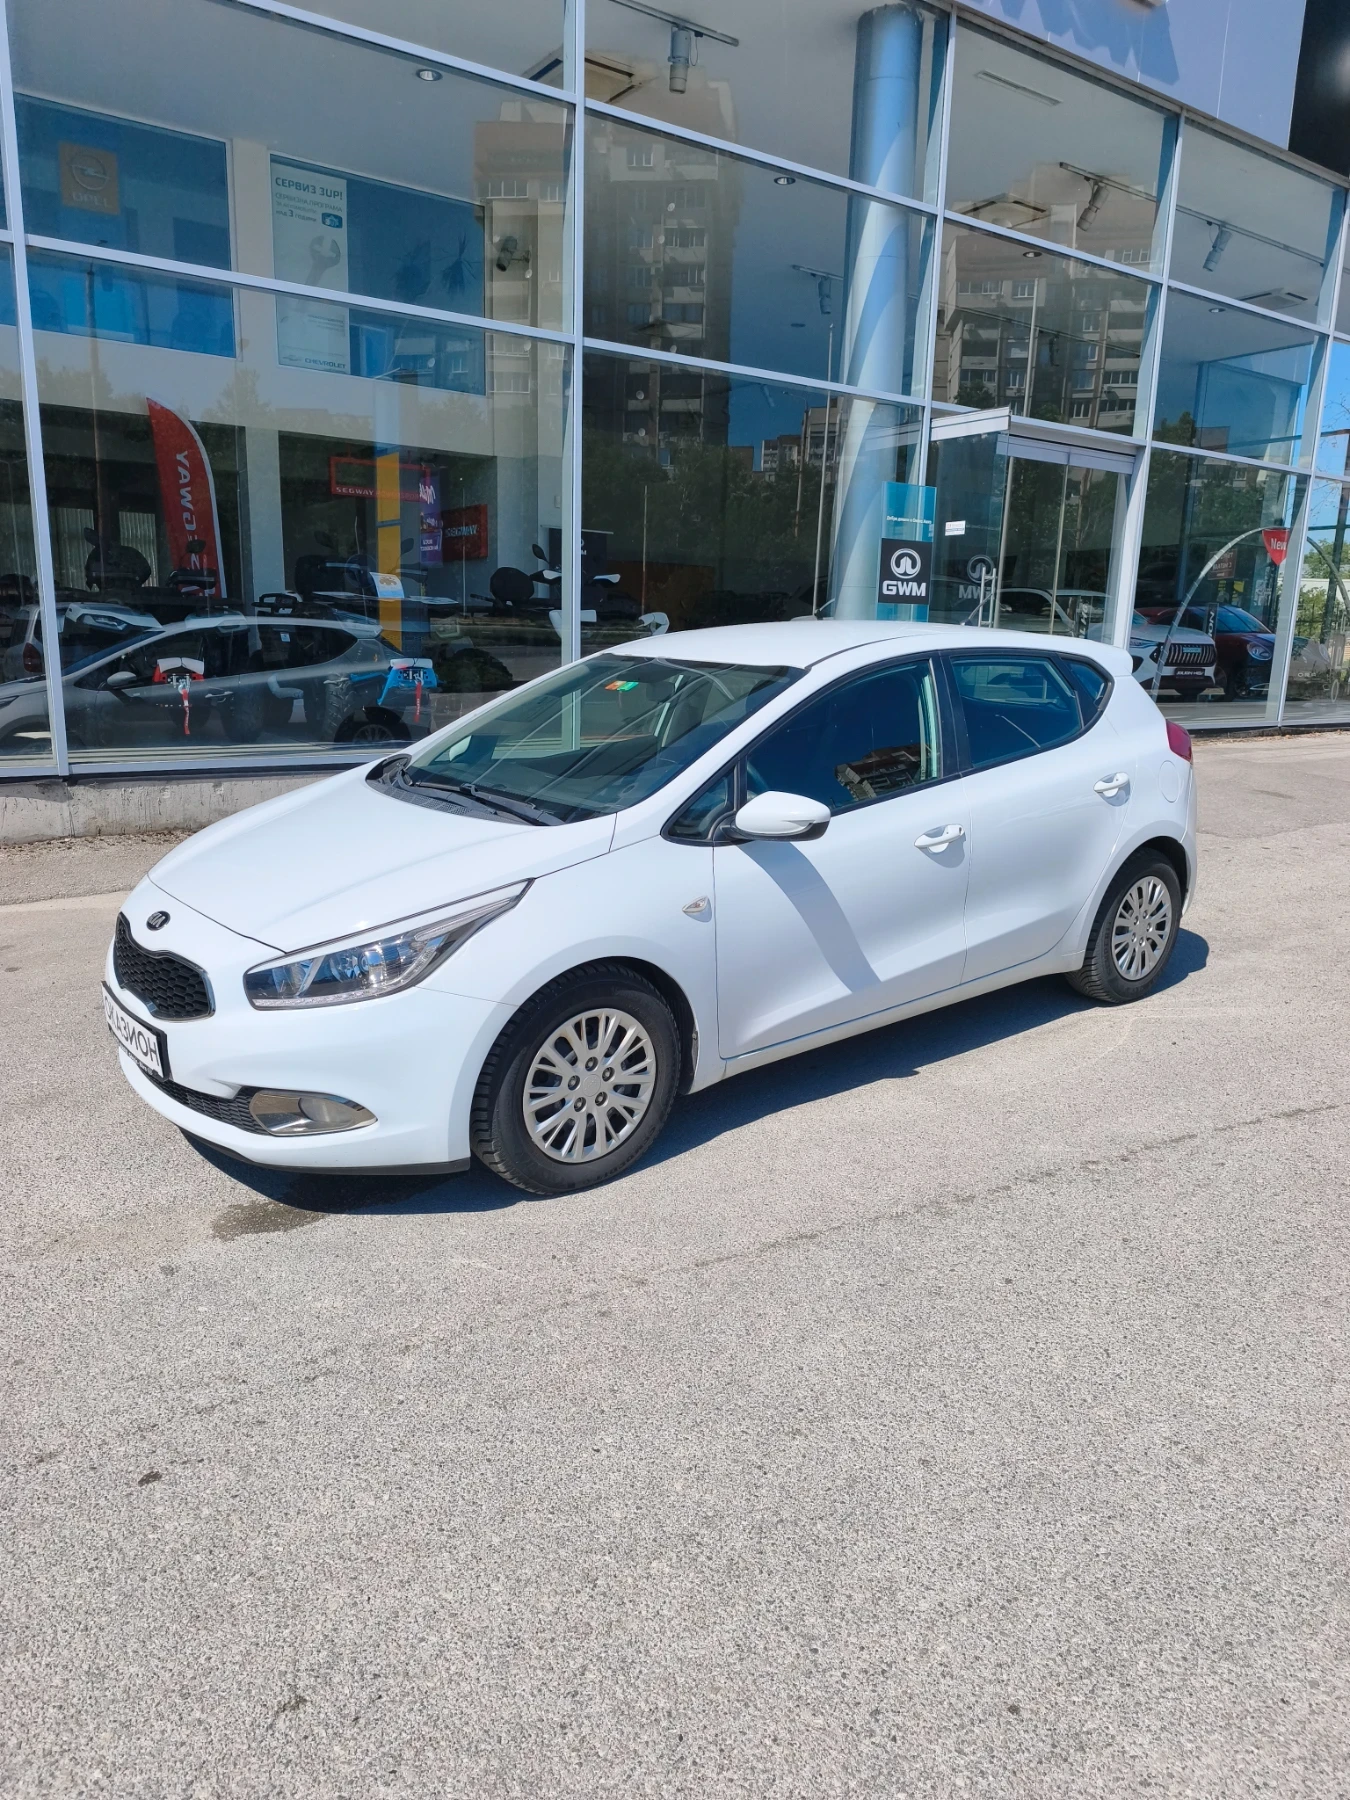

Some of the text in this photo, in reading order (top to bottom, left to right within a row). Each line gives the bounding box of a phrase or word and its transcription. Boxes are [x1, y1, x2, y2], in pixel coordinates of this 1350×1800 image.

[275, 177, 316, 194] СЕРВИЗ
[304, 357, 346, 369] CHEVROLET
[335, 486, 374, 496] SEGWAY
[1270, 537, 1287, 551] New
[882, 580, 926, 597] GWM
